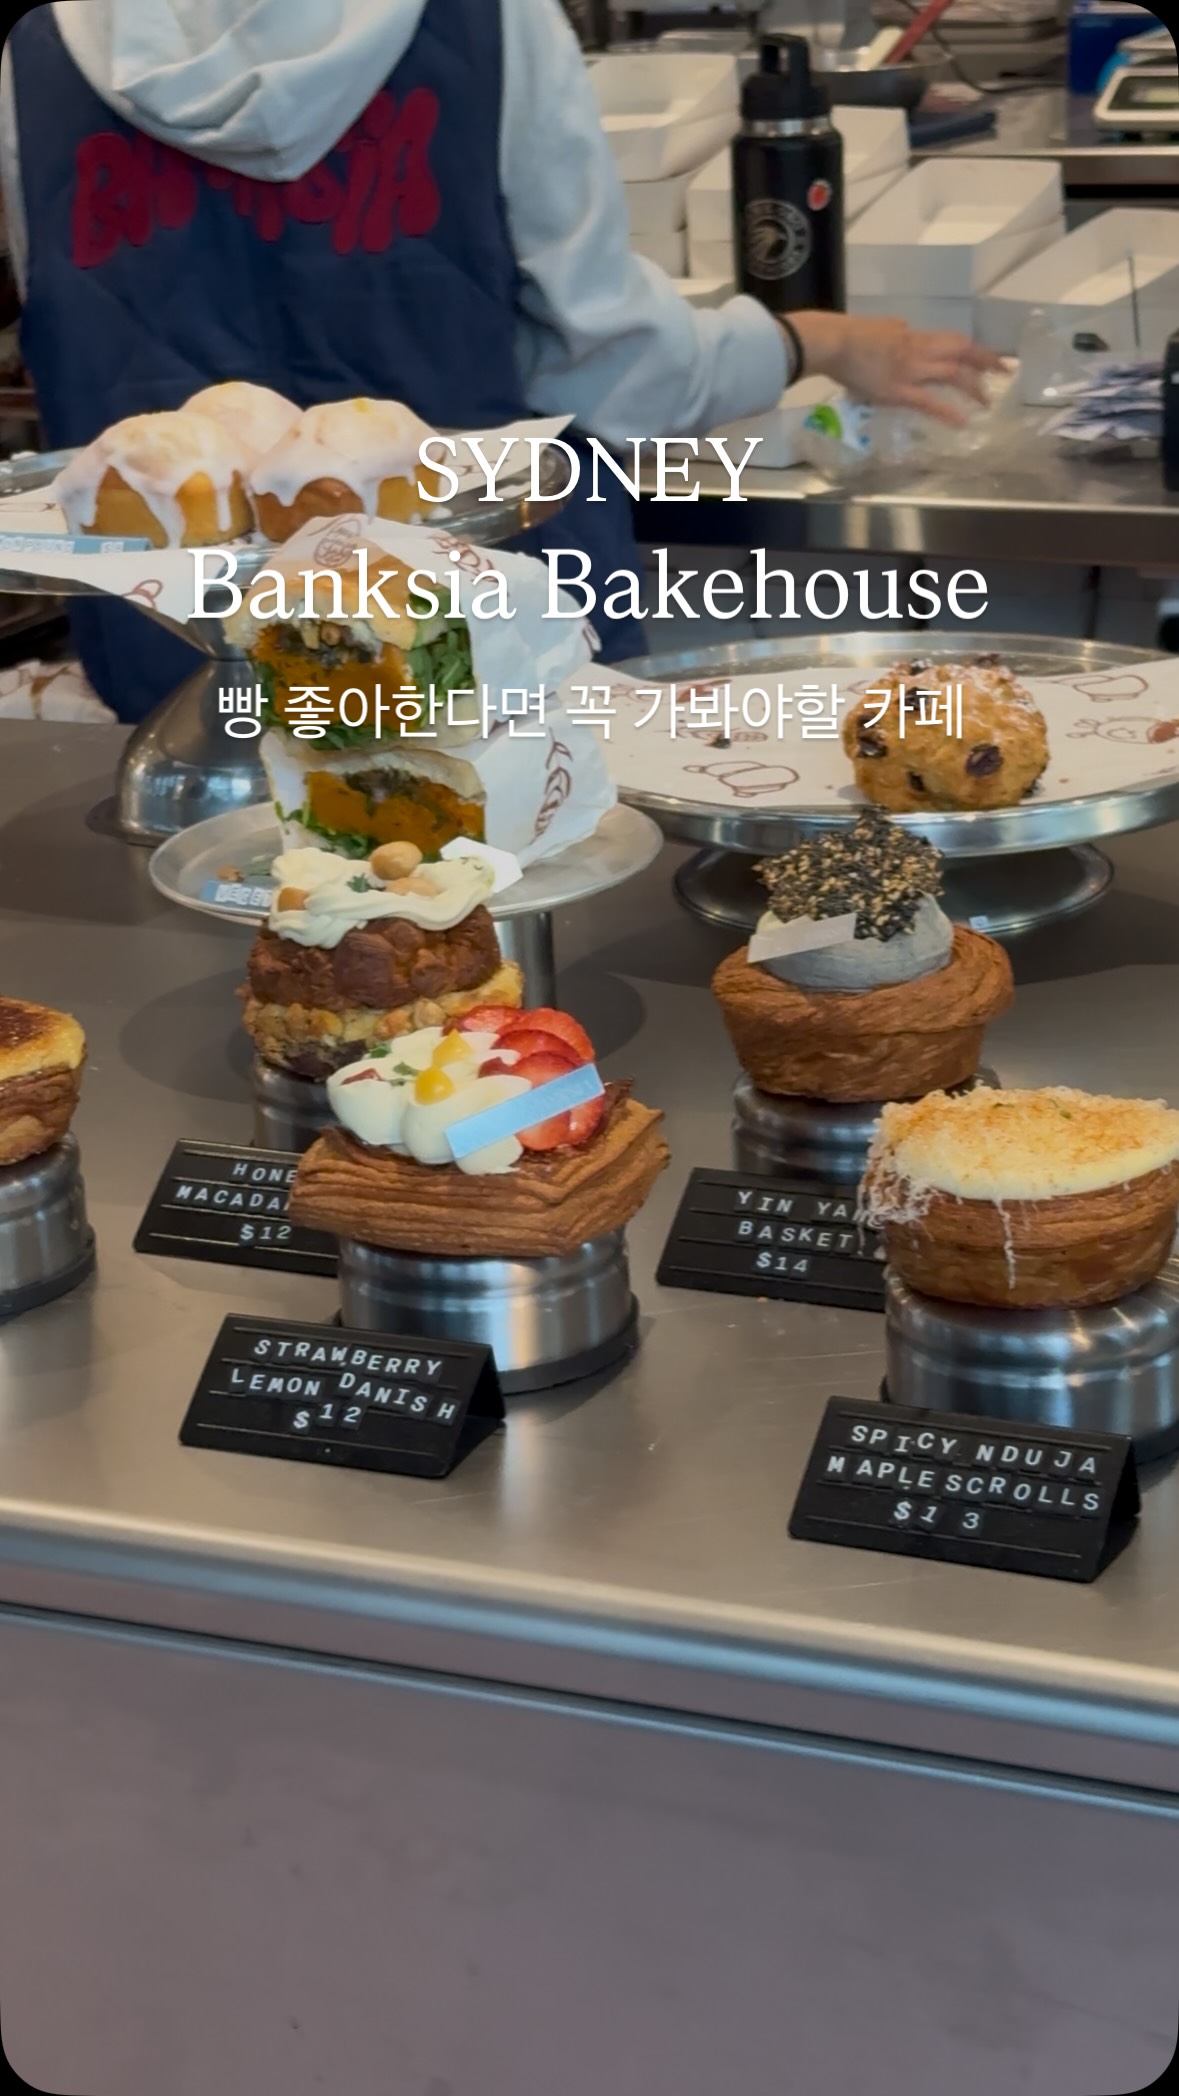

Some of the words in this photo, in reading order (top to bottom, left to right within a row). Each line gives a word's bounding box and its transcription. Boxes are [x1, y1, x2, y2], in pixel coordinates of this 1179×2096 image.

[232, 1162, 298, 1183] HONE
[175, 1184, 290, 1212] MACADA
[738, 1190, 794, 1213] YIN
[240, 1223, 292, 1241] $12
[738, 1220, 853, 1249] BASKET
[756, 1251, 809, 1273] $14
[253, 1338, 442, 1377] STRAWBERRY
[230, 1367, 322, 1397] LEMON
[338, 1372, 456, 1421] DANISH
[292, 1403, 363, 1430] $12
[850, 1424, 958, 1455] SPICY
[975, 1442, 1098, 1475] NDUJA
[826, 1455, 936, 1490] MAPLE
[944, 1473, 1100, 1512] SCROLLS
